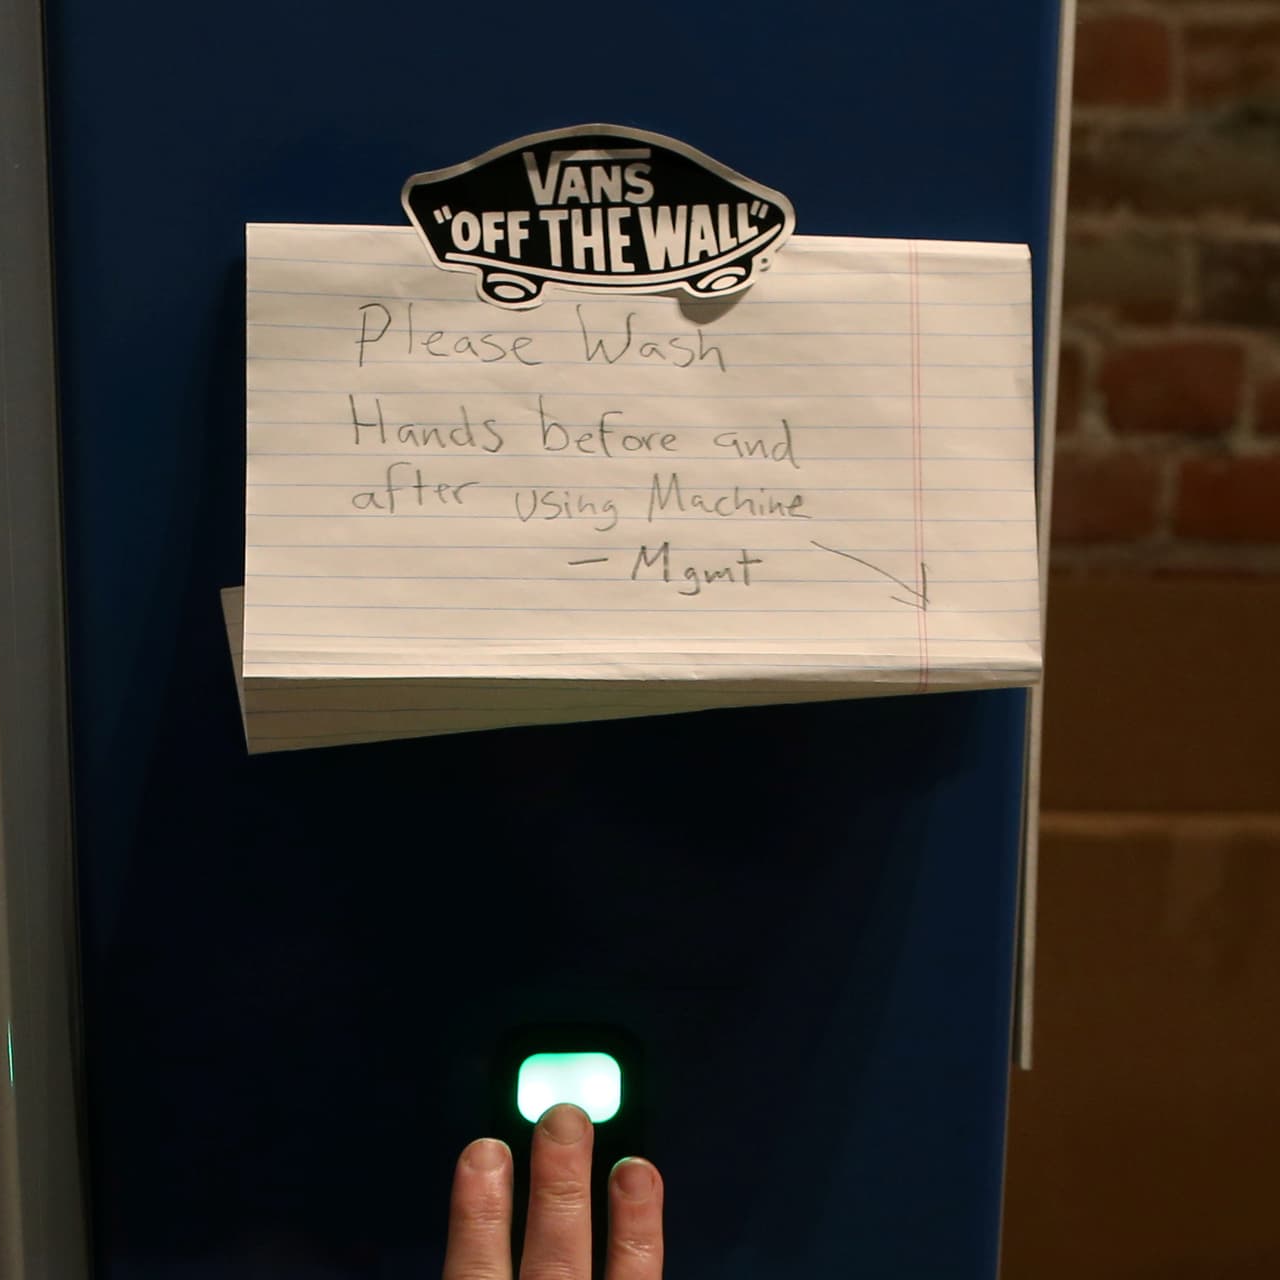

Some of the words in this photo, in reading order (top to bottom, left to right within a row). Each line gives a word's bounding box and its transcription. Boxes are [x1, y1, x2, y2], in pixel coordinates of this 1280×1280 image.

[521, 148, 655, 206] VANS
[539, 205, 635, 274] THE
[354, 302, 545, 369] Please
[576, 303, 728, 374] Wash
[348, 393, 505, 453] Hands
[539, 394, 681, 454] before
[712, 418, 804, 470] and
[350, 461, 481, 513] after
[514, 491, 620, 531] using
[647, 472, 814, 522] Machine
[630, 540, 764, 596] Mgmt
